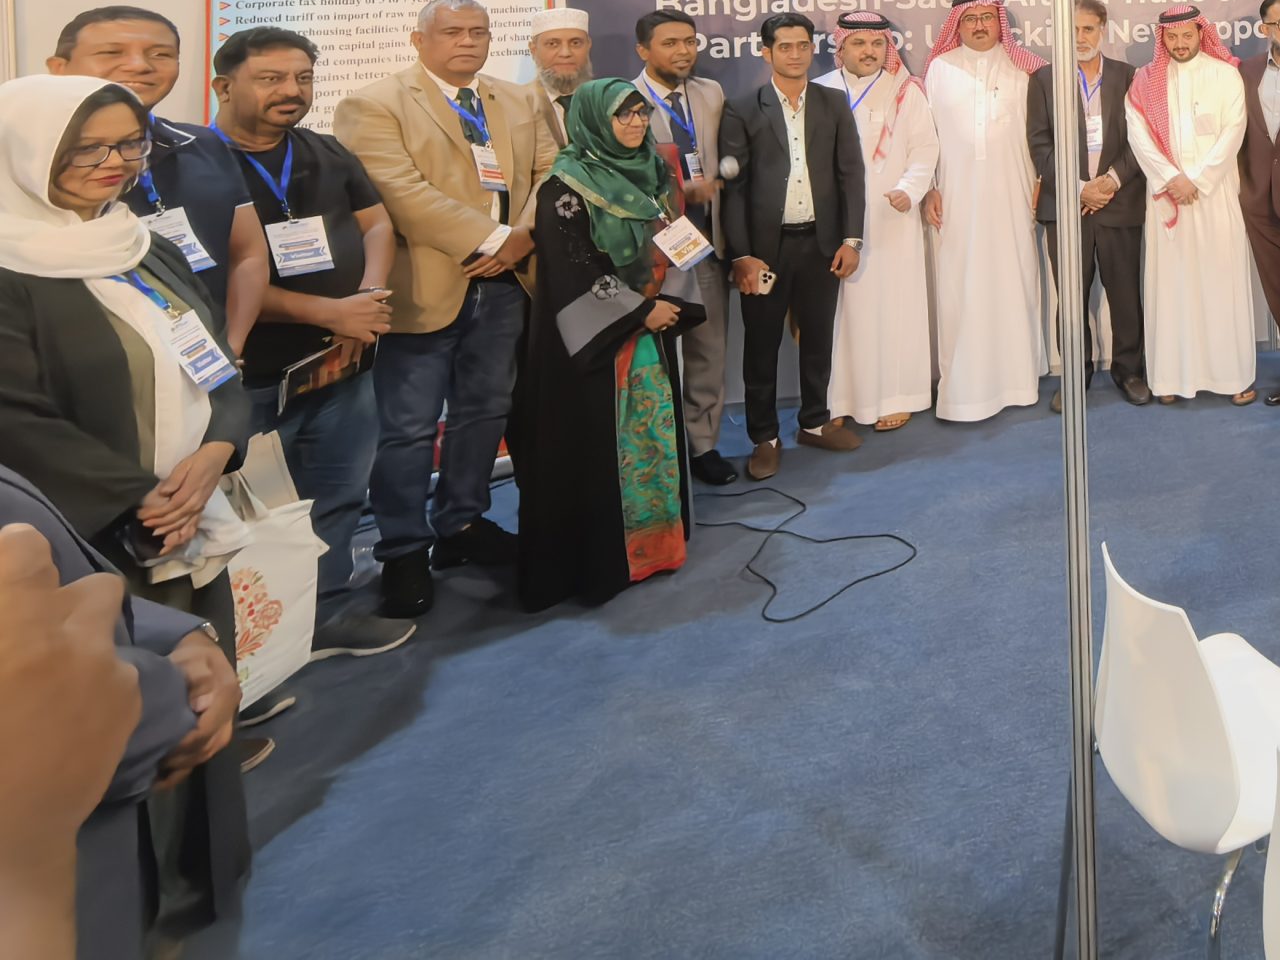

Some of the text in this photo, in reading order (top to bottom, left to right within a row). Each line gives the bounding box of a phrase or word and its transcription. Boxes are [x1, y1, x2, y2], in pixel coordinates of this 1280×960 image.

[235, 13, 282, 25] Reduced
[286, 12, 316, 22] tariff
[333, 12, 369, 22] import
[372, 10, 383, 18] of
[355, 24, 399, 35] facilities
[1108, 19, 1157, 44] Ne
[339, 40, 375, 52] capital
[378, 40, 406, 50] gains
[497, 34, 506, 42] of
[333, 56, 391, 67] companies
[490, 48, 531, 57] exchang
[313, 72, 351, 83] gainst
